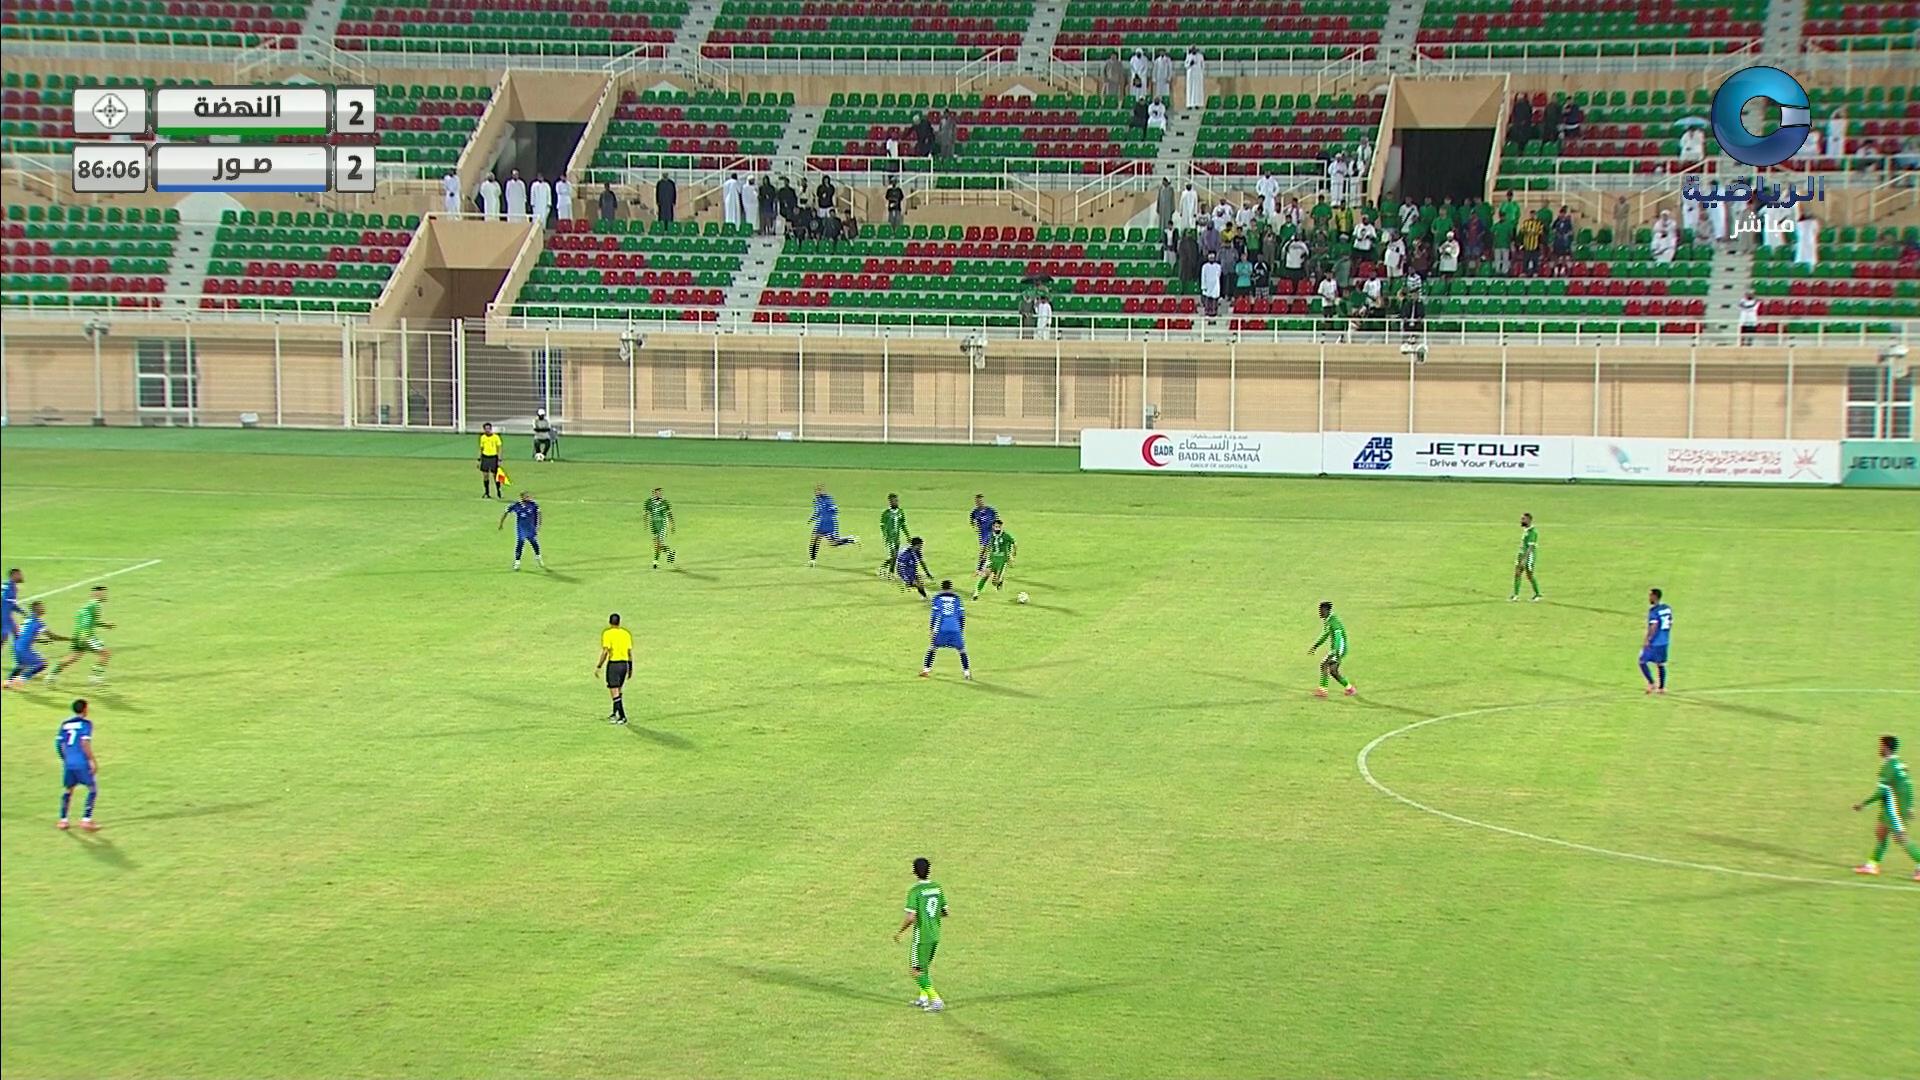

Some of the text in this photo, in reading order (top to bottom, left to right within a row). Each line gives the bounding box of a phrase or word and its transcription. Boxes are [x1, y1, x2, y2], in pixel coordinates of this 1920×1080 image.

[1153, 445, 1174, 456] BADR
[1354, 449, 1393, 462] MHD
[1416, 442, 1540, 457] JETOUR
[1178, 451, 1261, 463] BADR AL SAMAA
[1429, 458, 1525, 468] Drive Your Future
[1847, 456, 1917, 469] JETOUR
[66, 729, 77, 746] 7
